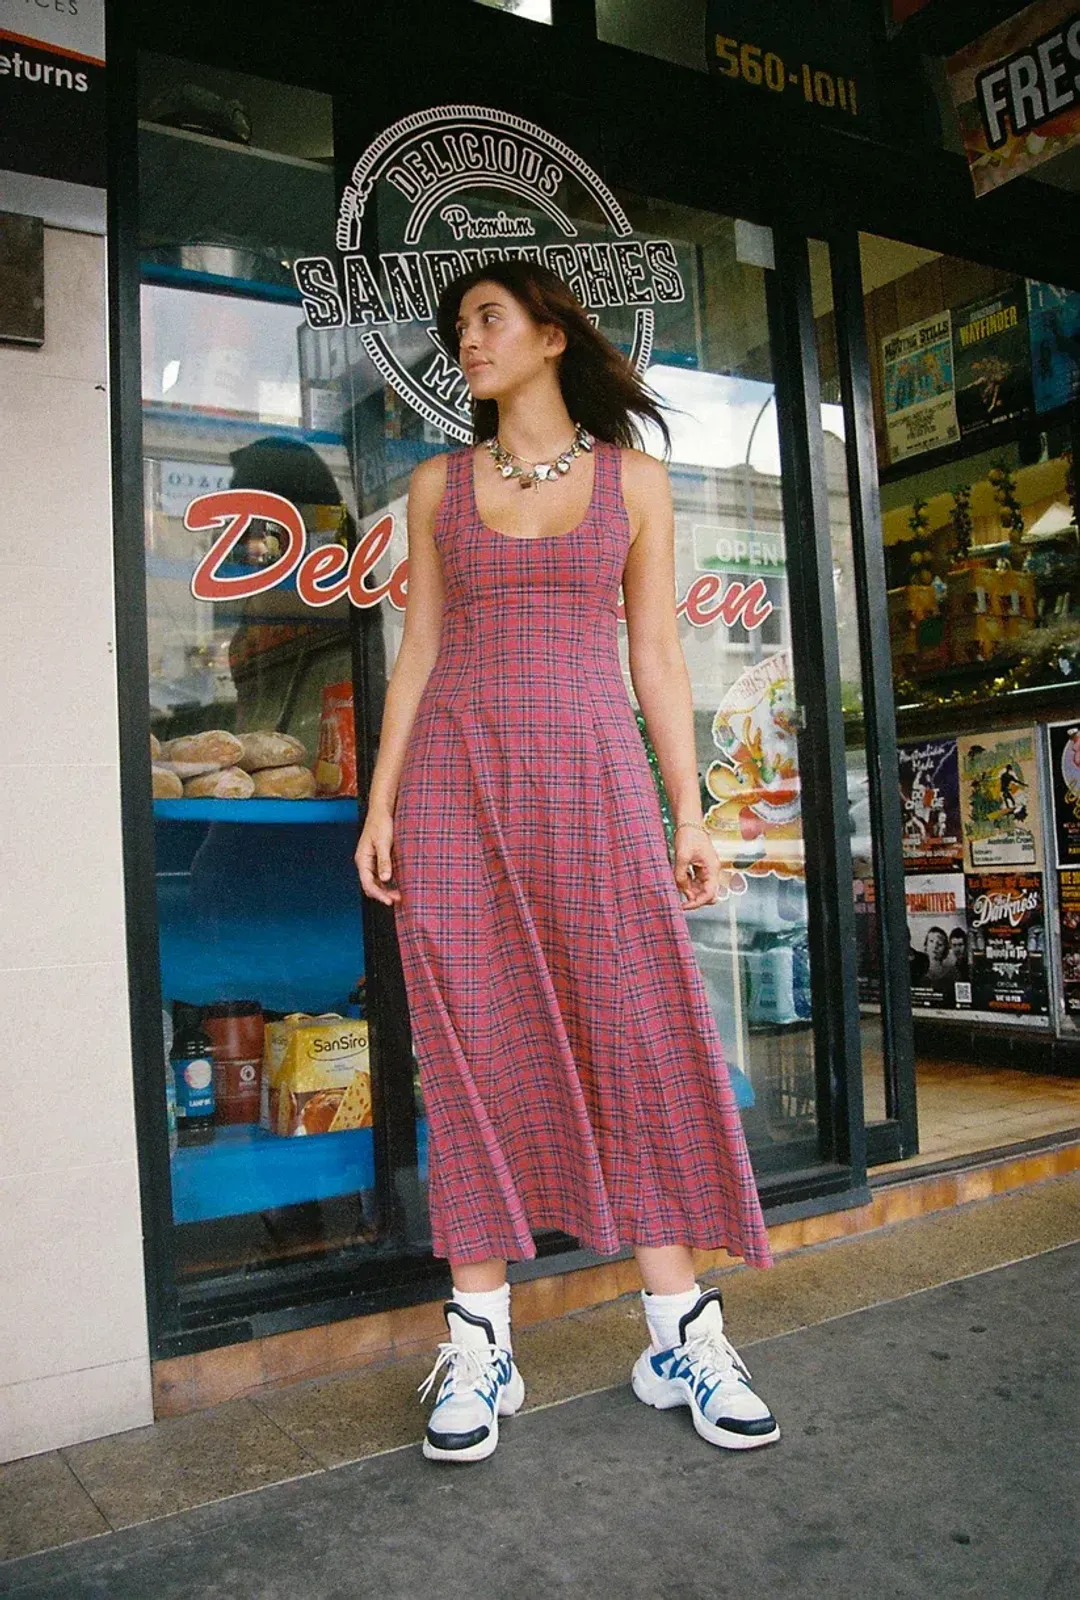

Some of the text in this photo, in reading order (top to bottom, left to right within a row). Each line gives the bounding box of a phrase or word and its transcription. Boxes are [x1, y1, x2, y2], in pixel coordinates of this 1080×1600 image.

[387, 133, 563, 203] DELICIOUS
[440, 204, 535, 240] Premium
[294, 241, 684, 330] SANDCHES
[959, 305, 1018, 346] WAYFINDER
[716, 537, 778, 567] OPEN
[313, 1033, 367, 1053] SanSiro
